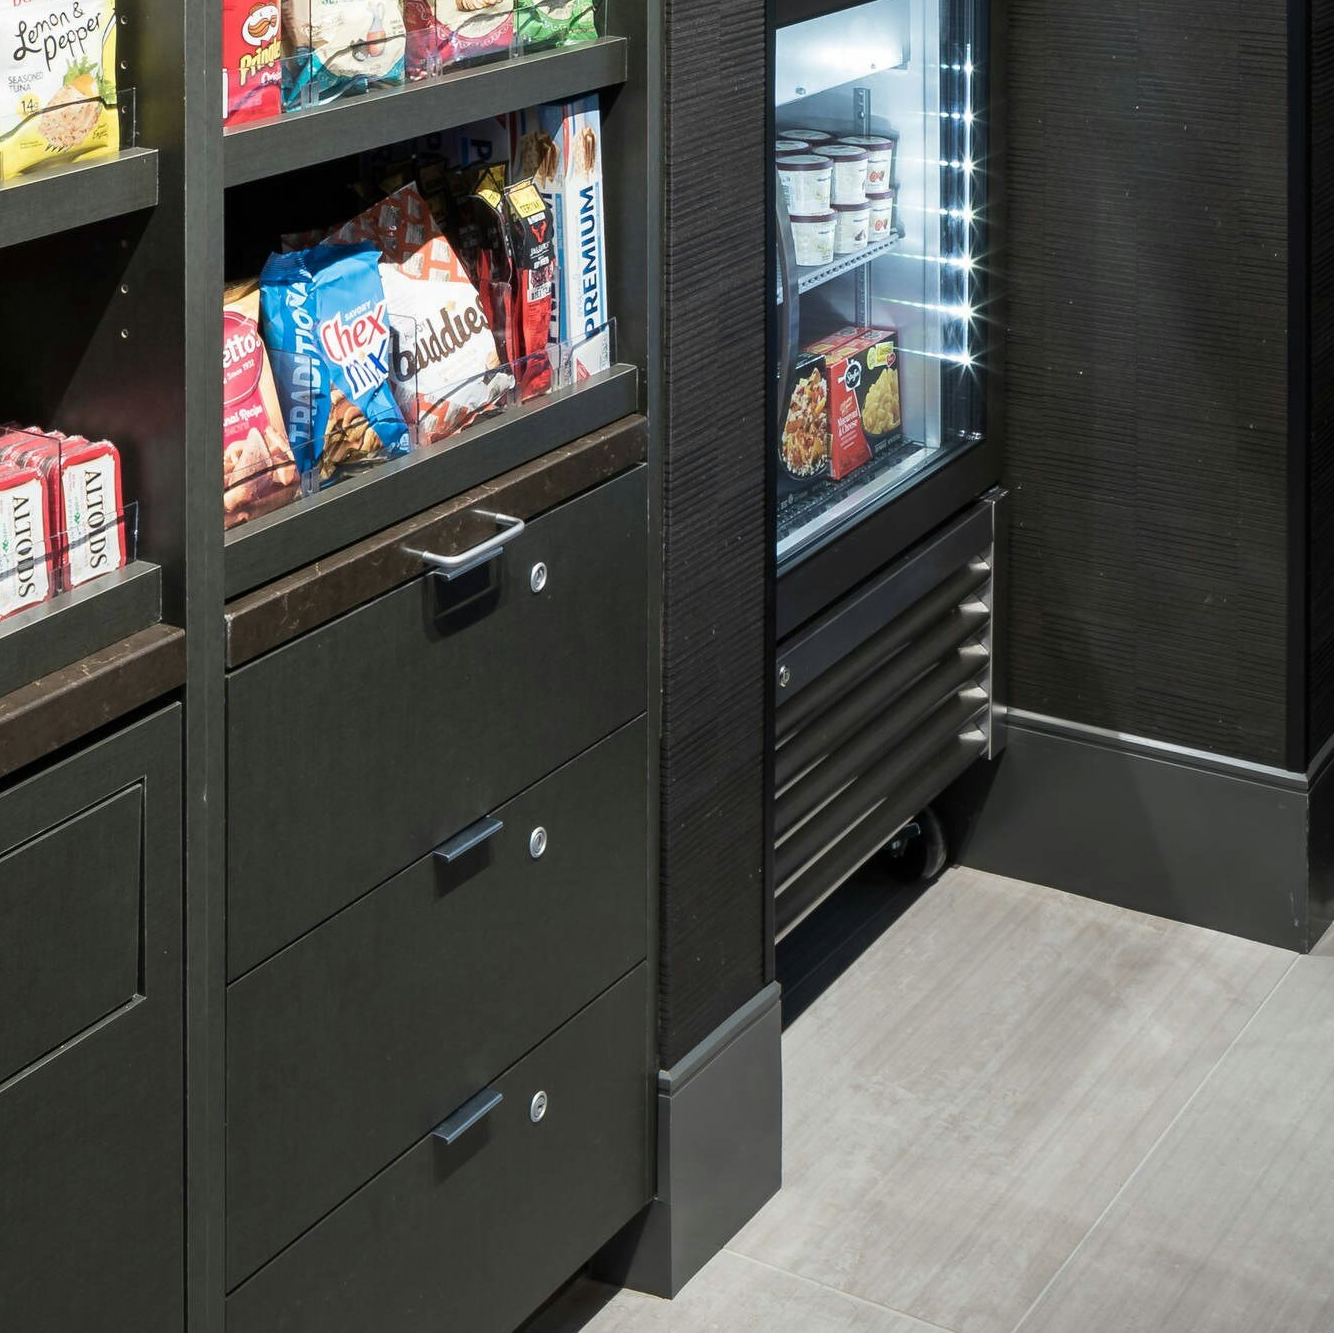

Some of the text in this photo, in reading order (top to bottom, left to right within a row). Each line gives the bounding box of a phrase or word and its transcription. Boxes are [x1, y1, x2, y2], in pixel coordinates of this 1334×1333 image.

[13, 1, 85, 62] Lemon &
[8, 71, 45, 84] SEASONED
[9, 82, 32, 93] TUNA
[579, 185, 599, 340] PREMIUM
[321, 303, 388, 362] Chex
[344, 301, 372, 322] SAVORY
[12, 494, 37, 600] ALTOIDS
[83, 467, 109, 570] ALTOIDS
